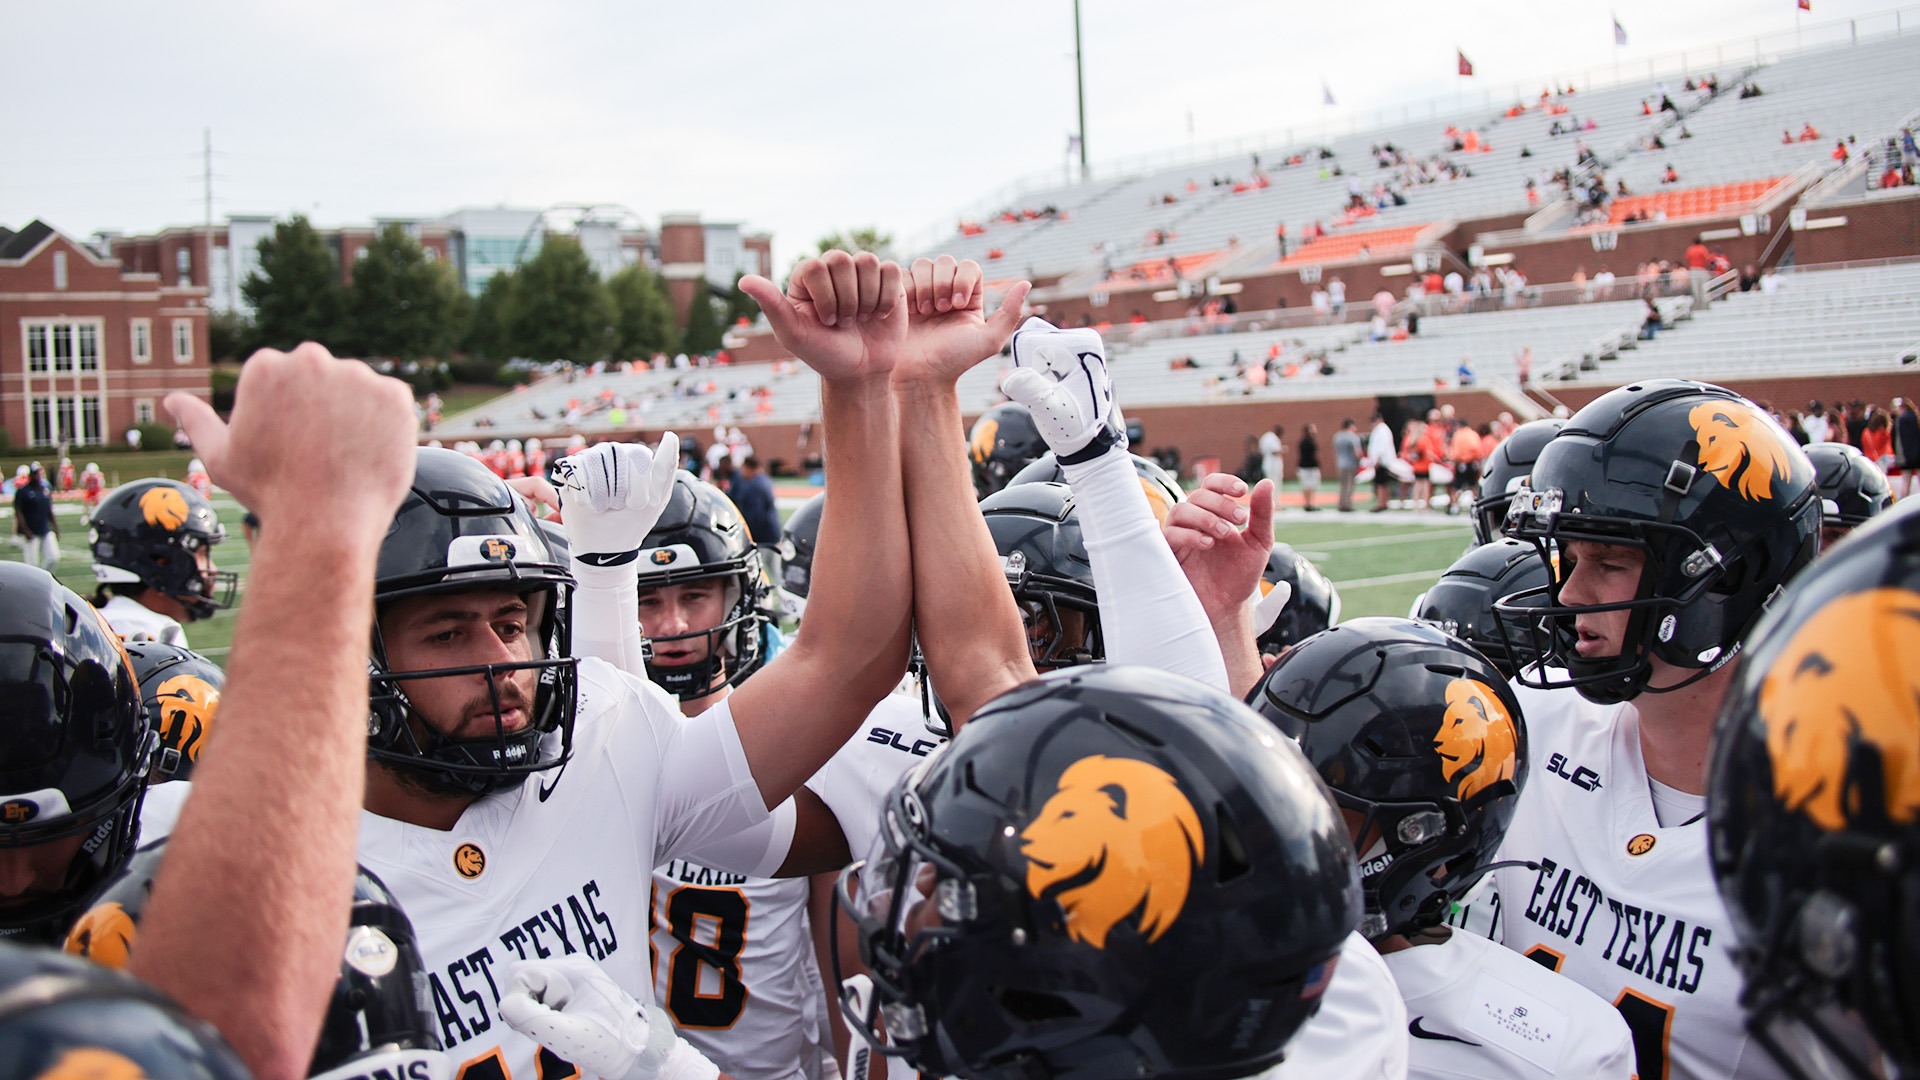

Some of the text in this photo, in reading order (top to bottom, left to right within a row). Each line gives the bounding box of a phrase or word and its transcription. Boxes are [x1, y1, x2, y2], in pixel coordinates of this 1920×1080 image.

[666, 673, 692, 683] Riddell
[492, 743, 527, 760] Rddell
[866, 727, 938, 757] SLC
[1546, 752, 1601, 792] SLC
[1524, 857, 1603, 946] EAST
[1602, 897, 1712, 994] TEXAS
[649, 881, 751, 1031] 8
[428, 946, 504, 1049] AST
[1484, 1002, 1552, 1040] ARCHER
